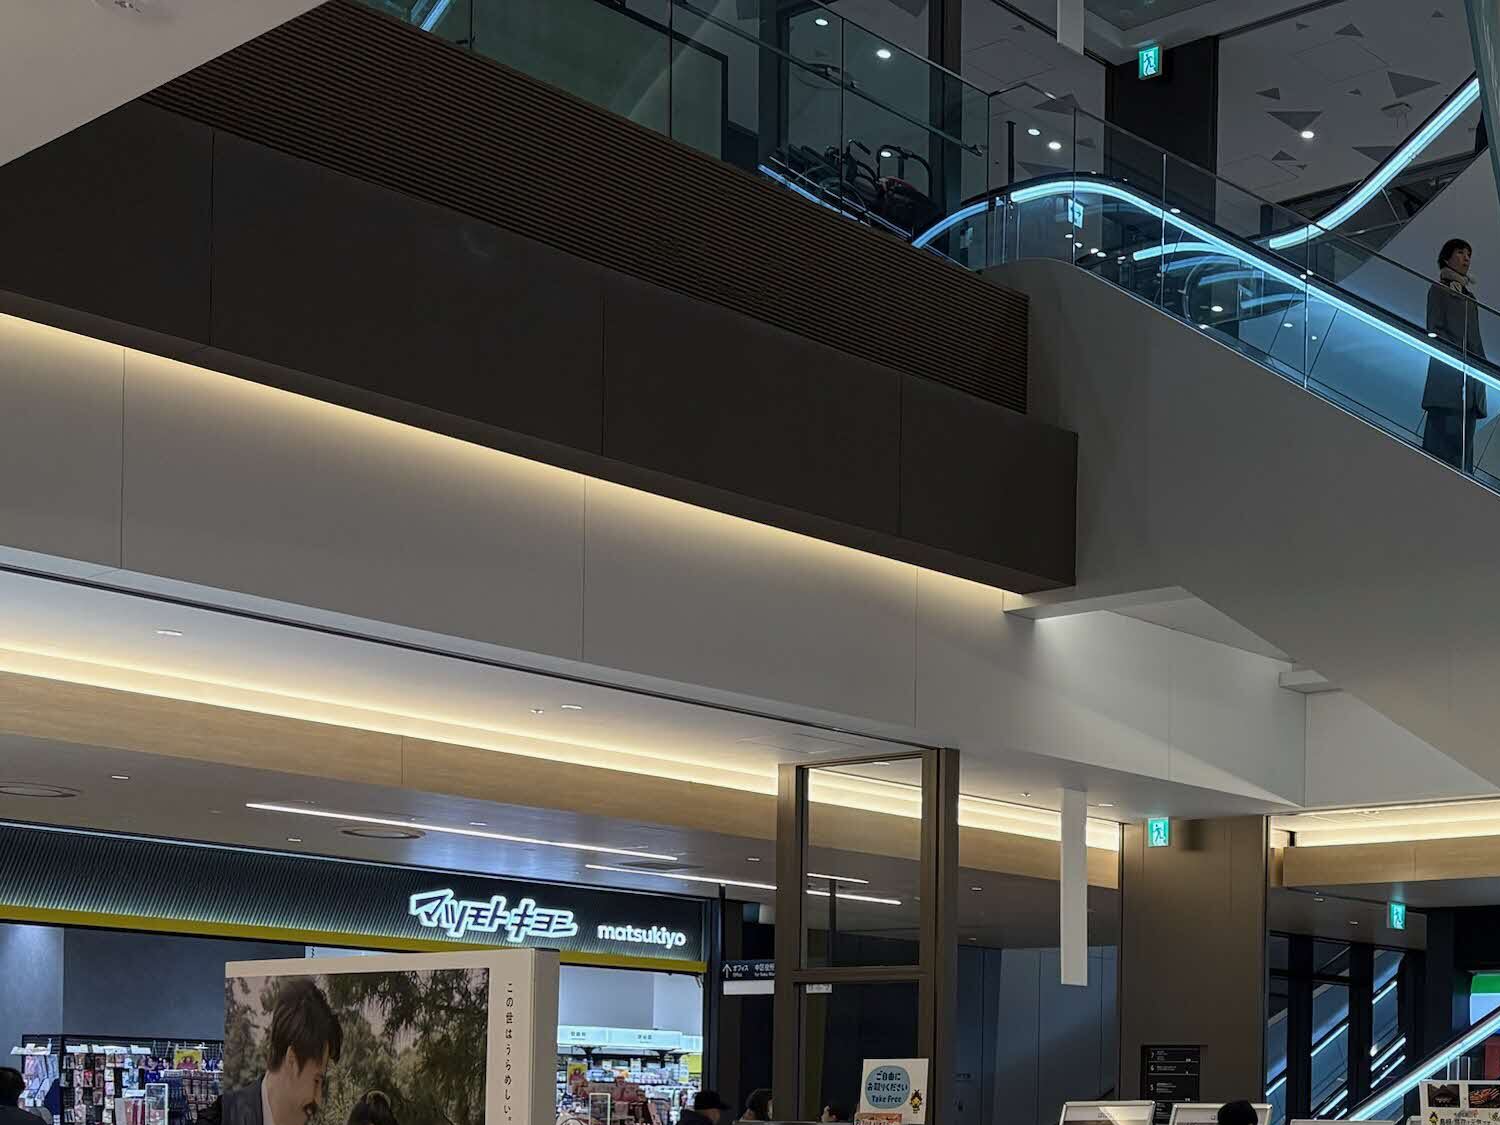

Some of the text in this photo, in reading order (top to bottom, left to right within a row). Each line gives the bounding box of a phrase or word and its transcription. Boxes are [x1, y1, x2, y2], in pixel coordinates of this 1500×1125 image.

[597, 924, 687, 949] matsukiyo
[876, 1070, 901, 1081] ご自由に
[867, 1082, 908, 1092] お取りください
[872, 1094, 902, 1103] Take Free
